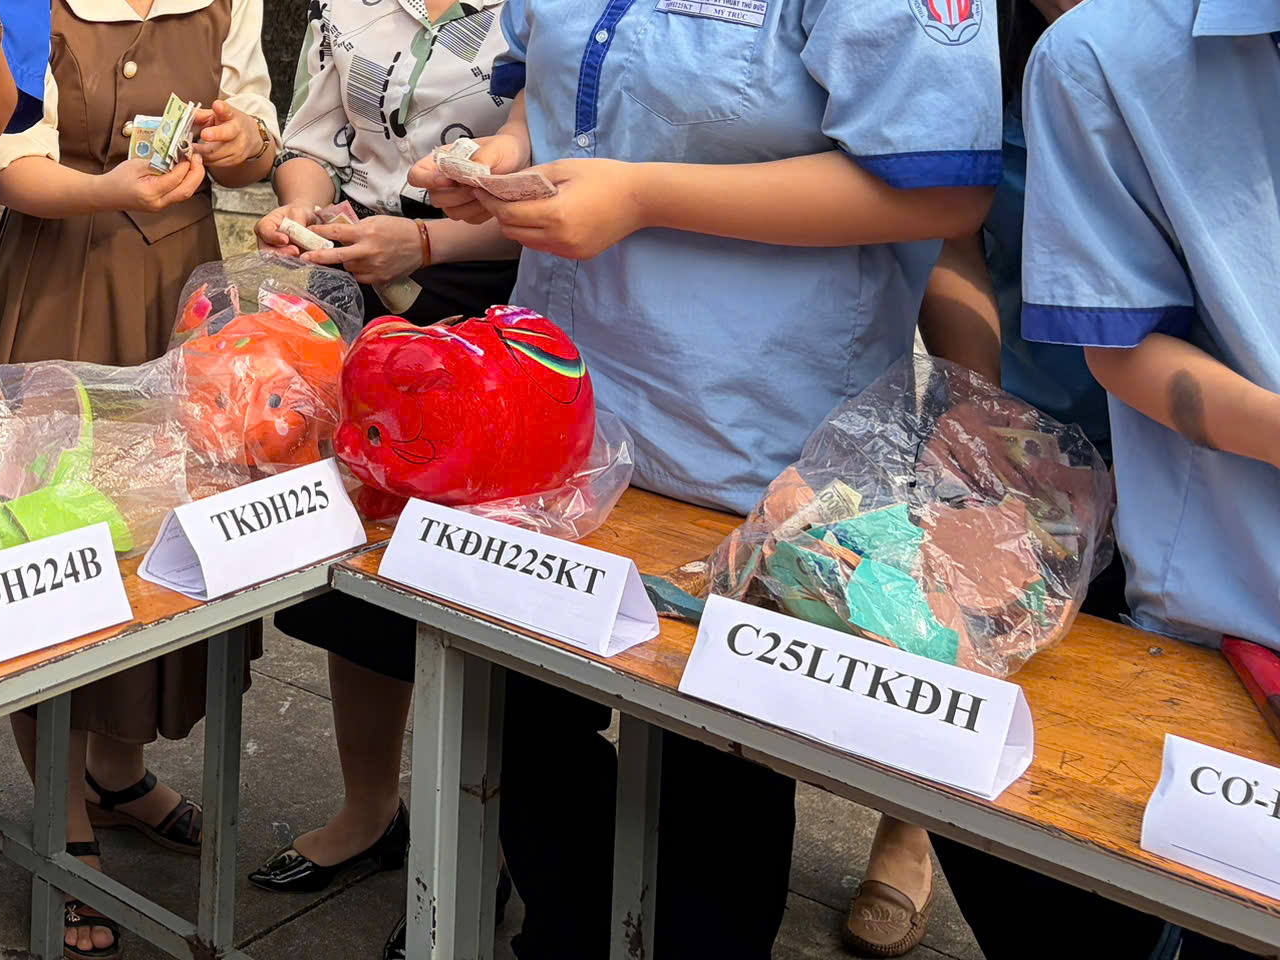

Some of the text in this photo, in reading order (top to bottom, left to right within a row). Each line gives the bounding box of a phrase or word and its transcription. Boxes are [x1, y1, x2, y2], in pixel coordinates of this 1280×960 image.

[210, 480, 329, 542] TKĐH225
[418, 517, 606, 595] TKĐH225KT
[727, 623, 987, 733] C25LTKĐH
